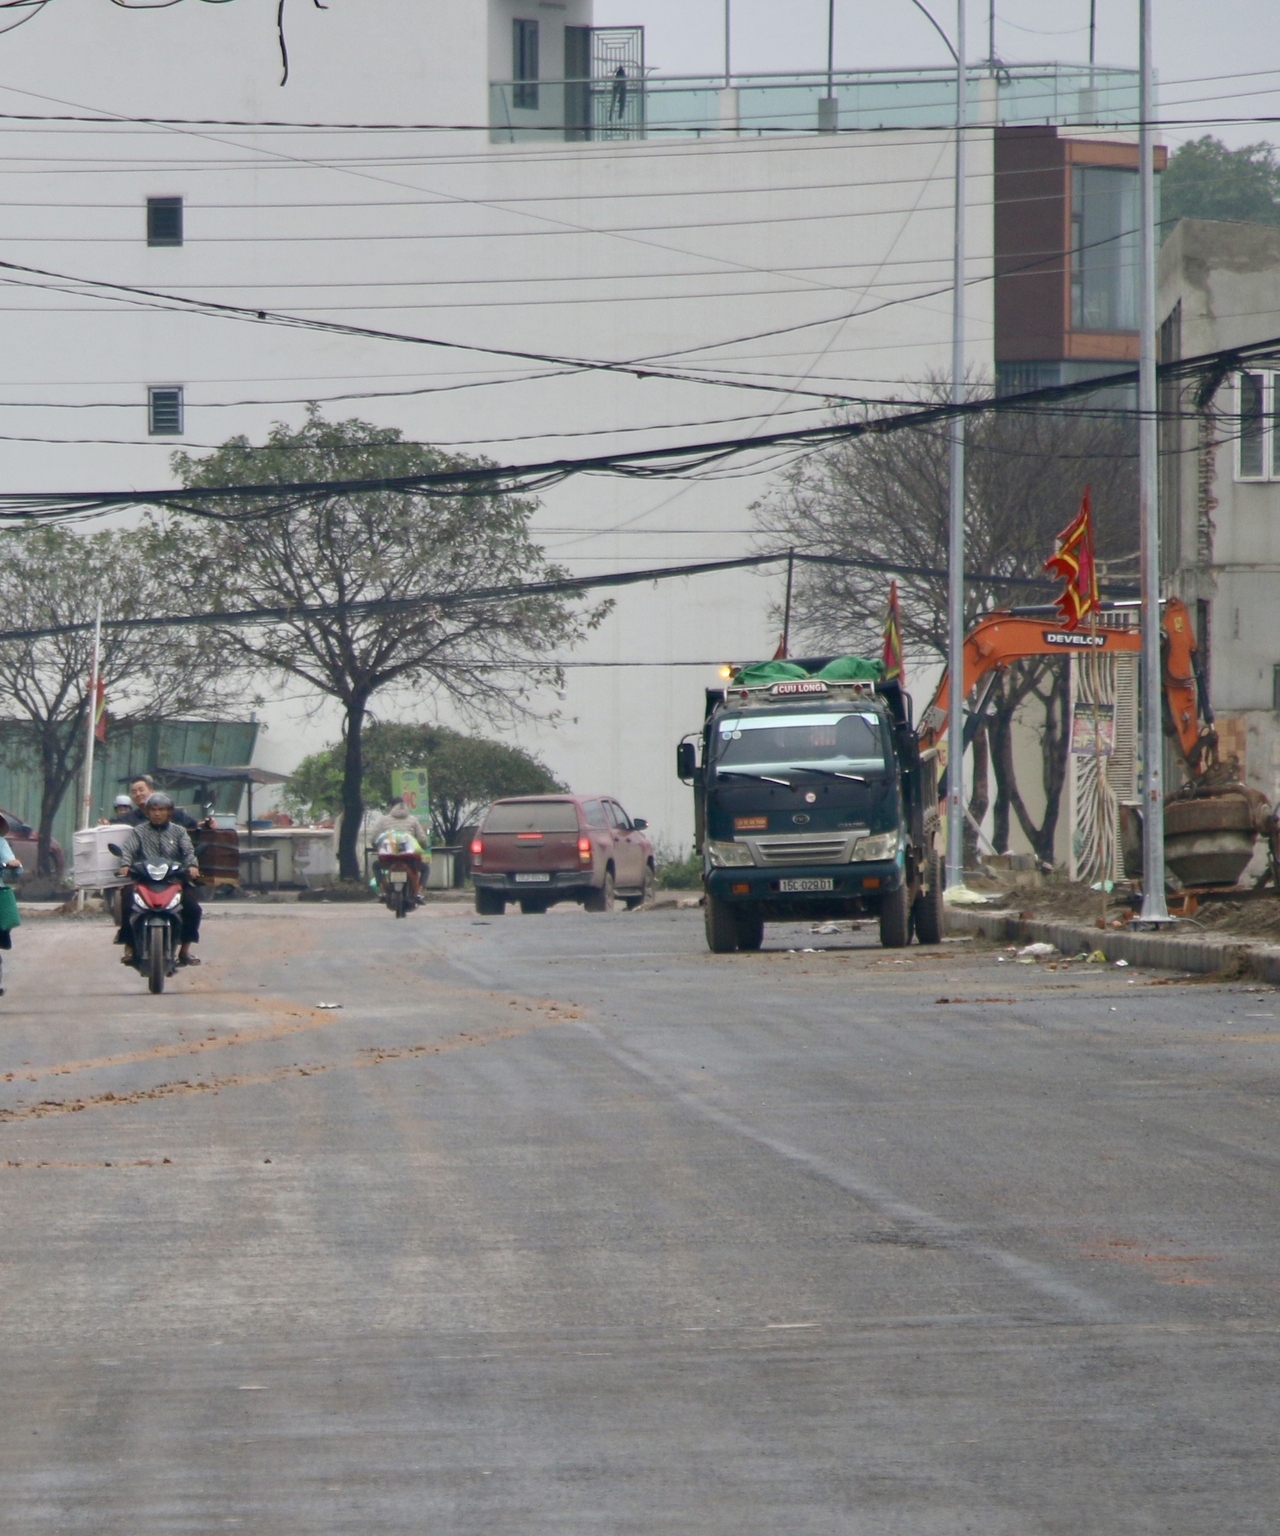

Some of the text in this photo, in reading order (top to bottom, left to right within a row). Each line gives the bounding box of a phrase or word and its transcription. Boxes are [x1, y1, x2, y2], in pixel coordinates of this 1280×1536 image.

[1047, 633, 1104, 646] DEVELON
[779, 684, 821, 694] CUU LONG
